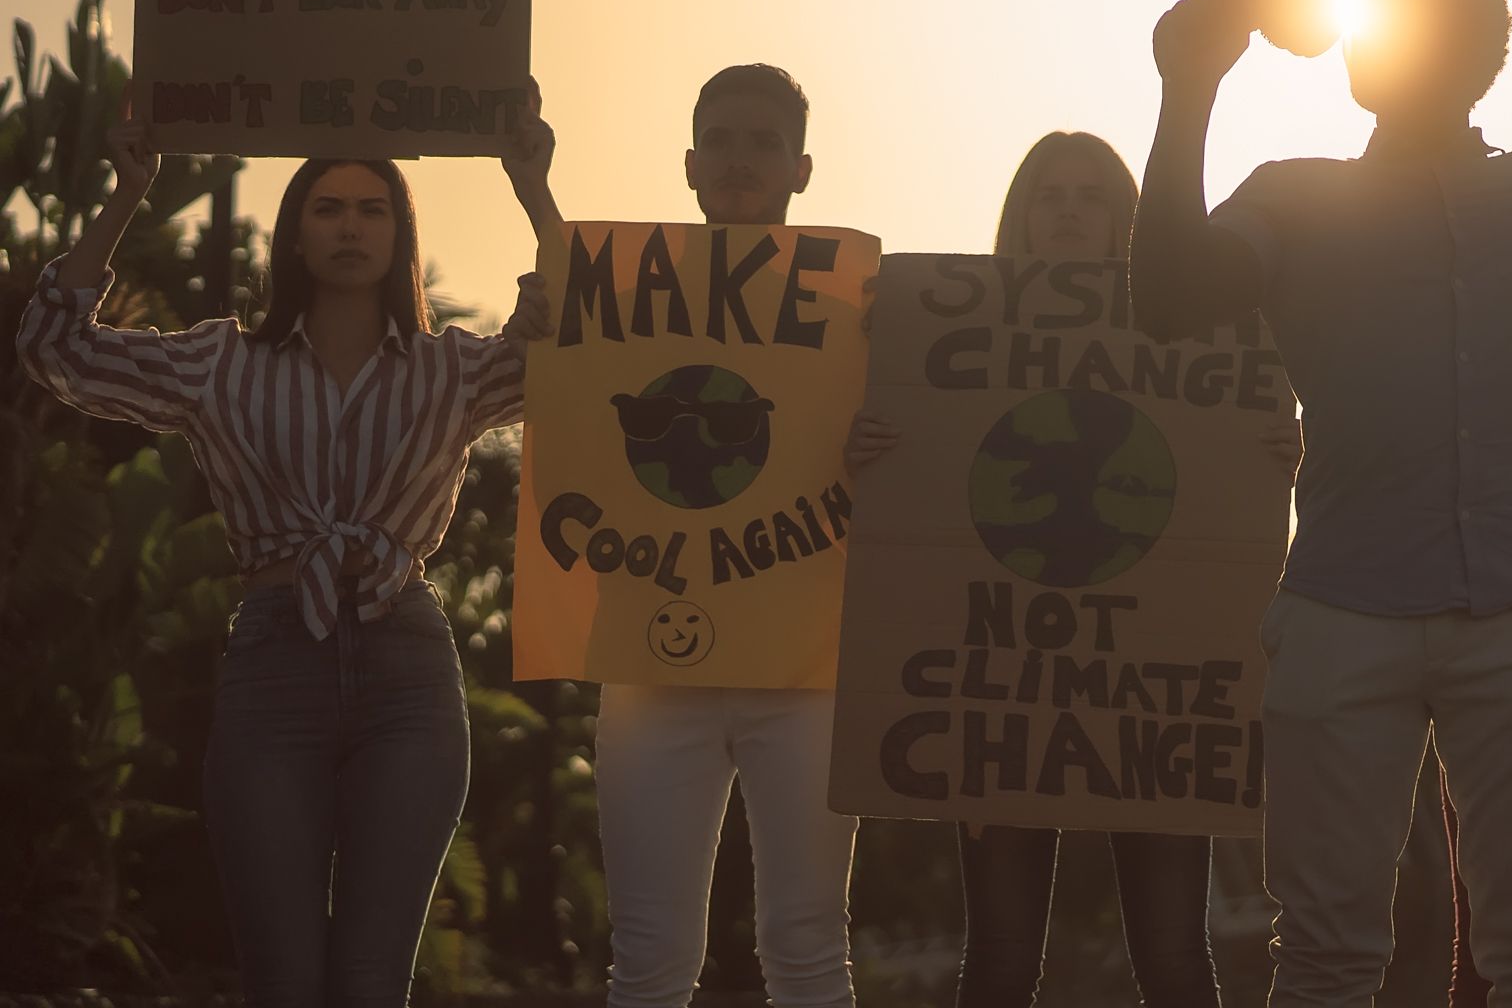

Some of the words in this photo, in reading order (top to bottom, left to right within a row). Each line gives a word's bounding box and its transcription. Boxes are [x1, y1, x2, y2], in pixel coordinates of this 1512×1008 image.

[300, 77, 355, 128] BE
[557, 222, 842, 351] MAKE
[919, 255, 1262, 348] SYST
[924, 326, 1286, 413] CHANGE
[963, 580, 1139, 653] NOT
[879, 710, 1265, 810] CHANGE!
